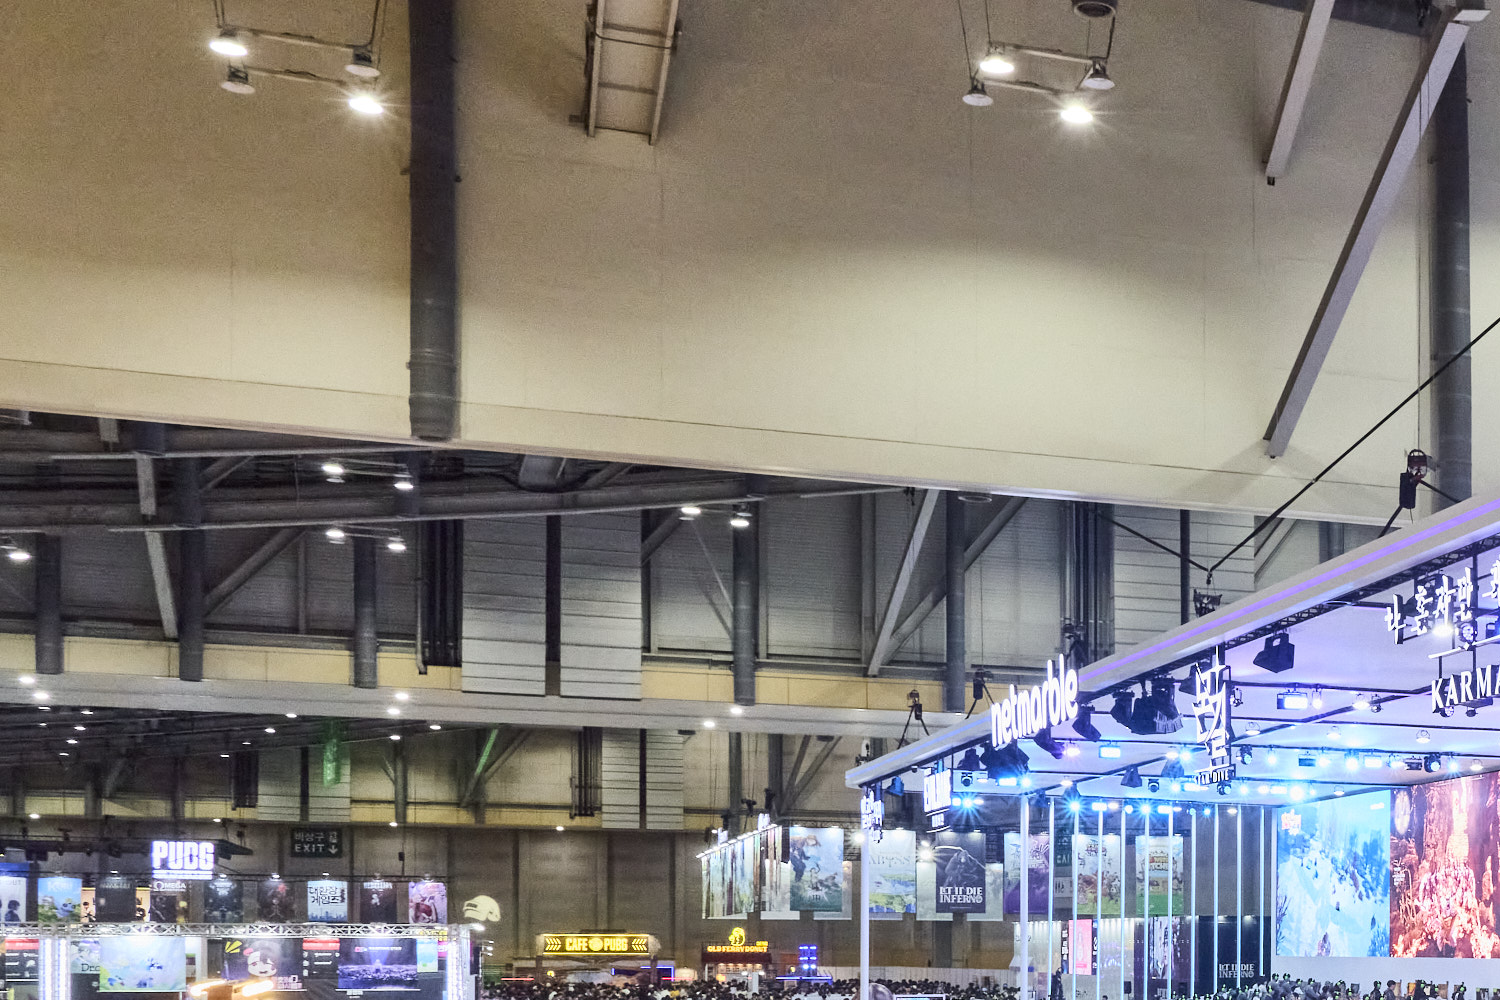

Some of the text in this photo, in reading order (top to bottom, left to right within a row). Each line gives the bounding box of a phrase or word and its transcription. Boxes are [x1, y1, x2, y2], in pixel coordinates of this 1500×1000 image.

[991, 653, 1079, 747] netmarble
[294, 831, 325, 842] 비상구
[294, 844, 325, 853] EXIT
[152, 840, 214, 870] PUBG
[965, 886, 984, 896] DIE
[939, 894, 984, 904] INFERNO
[565, 937, 628, 952] CAFE PUBG
[707, 945, 769, 953] OLD FERRY DONUT
